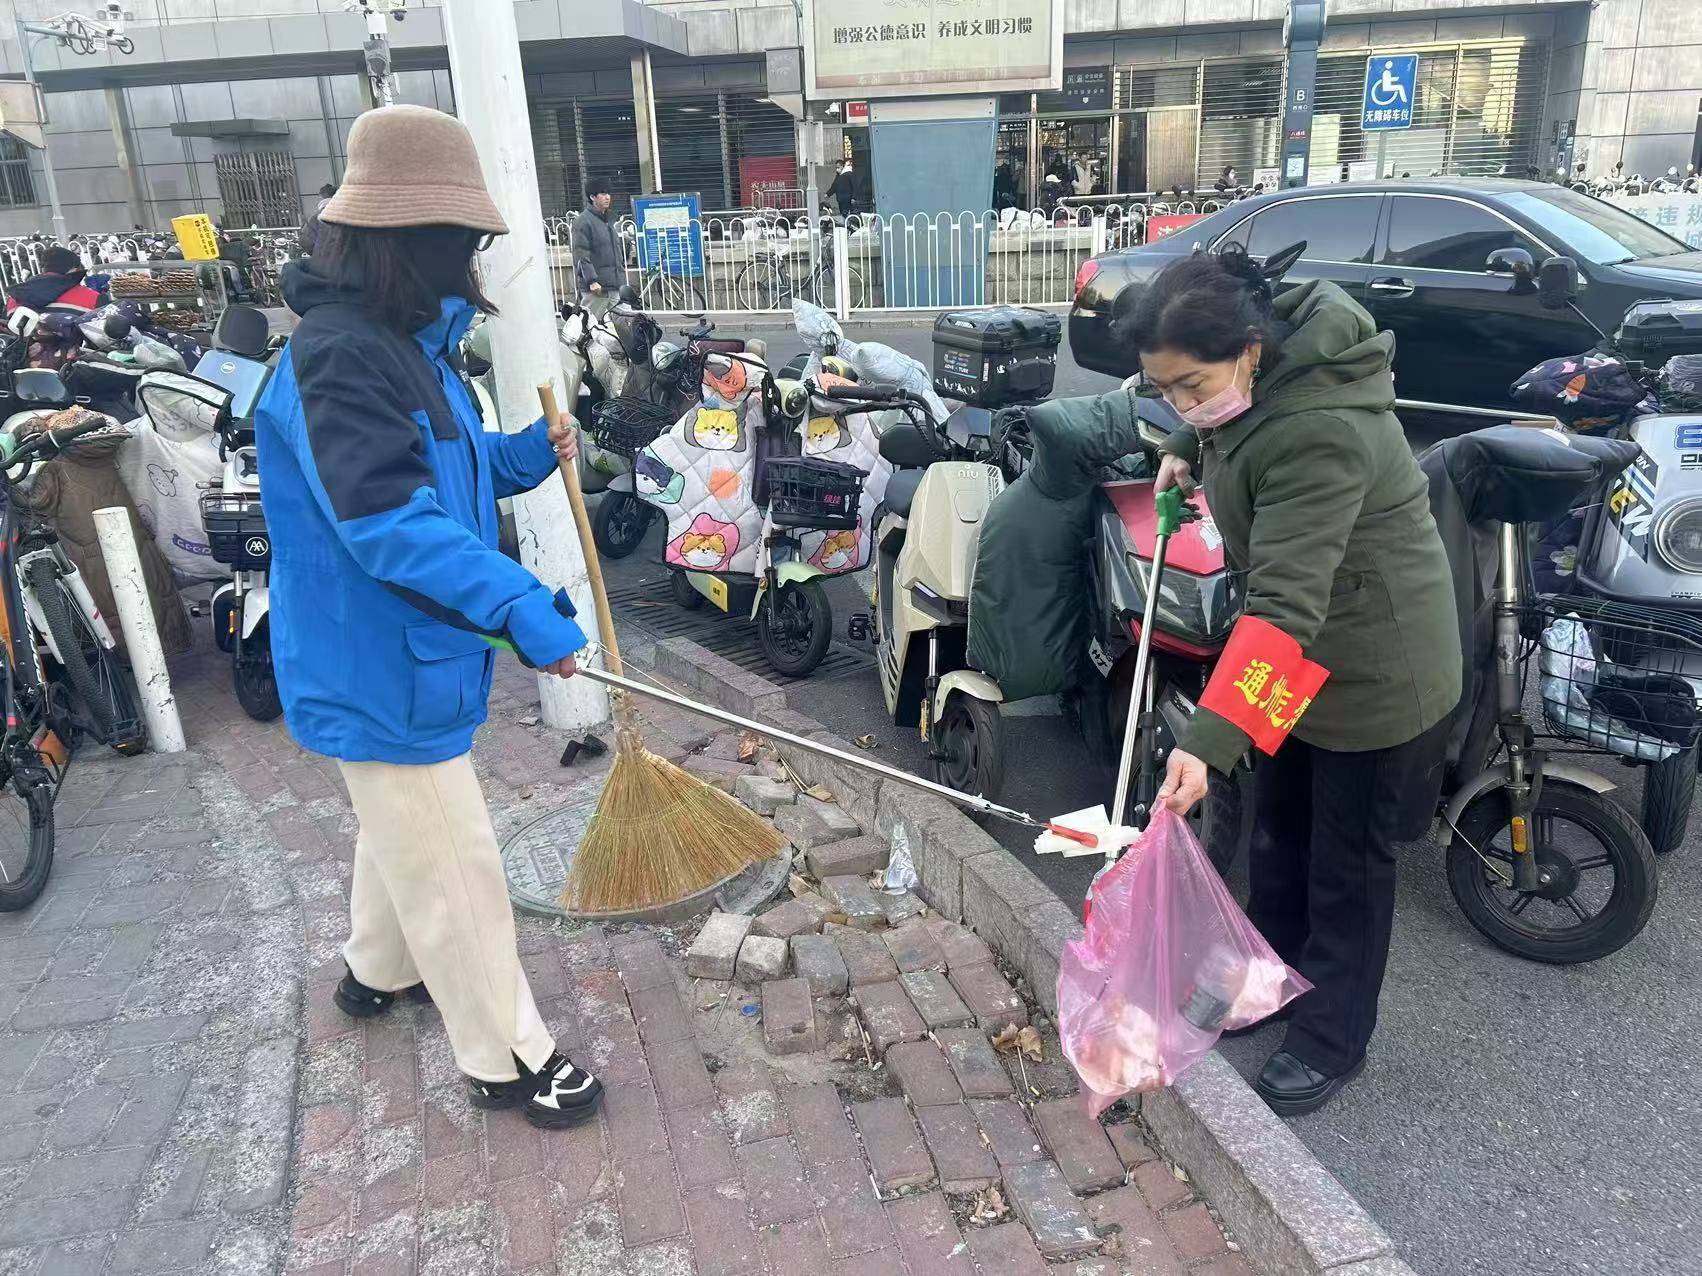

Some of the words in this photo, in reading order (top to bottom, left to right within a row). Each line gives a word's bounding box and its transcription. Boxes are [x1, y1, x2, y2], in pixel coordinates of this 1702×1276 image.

[833, 23, 926, 43] 增强公德意识
[938, 17, 1032, 38] 养成文明习惯
[1296, 90, 1305, 101] B
[1365, 109, 1409, 123] 无障碍车位
